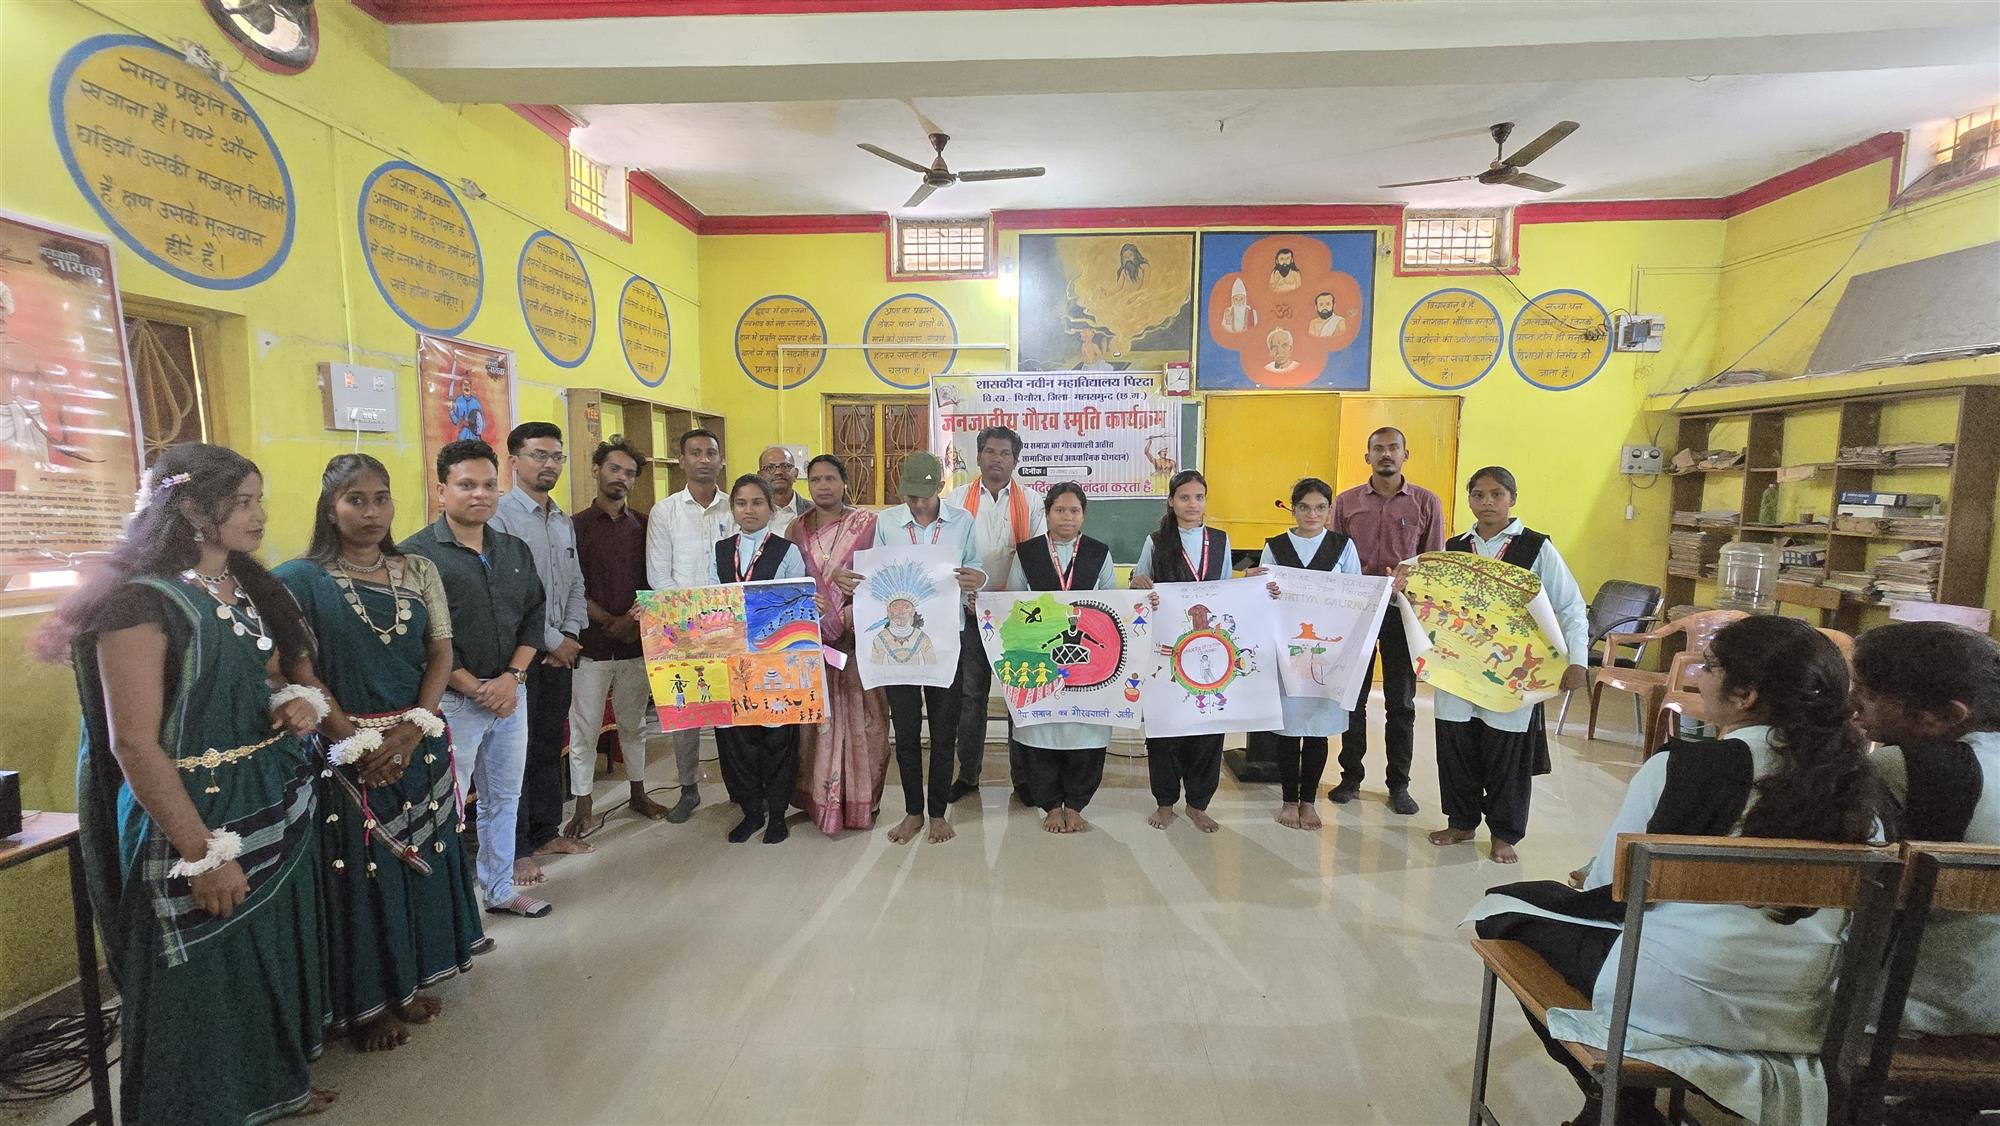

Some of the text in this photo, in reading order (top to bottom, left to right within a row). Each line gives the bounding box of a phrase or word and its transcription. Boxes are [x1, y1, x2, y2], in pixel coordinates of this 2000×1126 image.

[120, 56, 169, 91] समय
[231, 107, 249, 126] का
[80, 79, 150, 120] खजाना
[222, 137, 258, 164] और
[139, 149, 190, 178] उसकी
[197, 169, 244, 206] मजबूत
[249, 184, 286, 216] तिजोरी
[122, 189, 154, 213] क्षण
[159, 201, 199, 227] उसके
[977, 375, 1154, 389] शासकीय नवीन महाविद्यालय पिरदा
[941, 404, 1167, 436] जनजातीय गौरव स्मृति कार्यक्रम
[1051, 441, 1060, 449] का
[1111, 482, 1141, 493] करता
[1032, 709, 1053, 719] समाज
